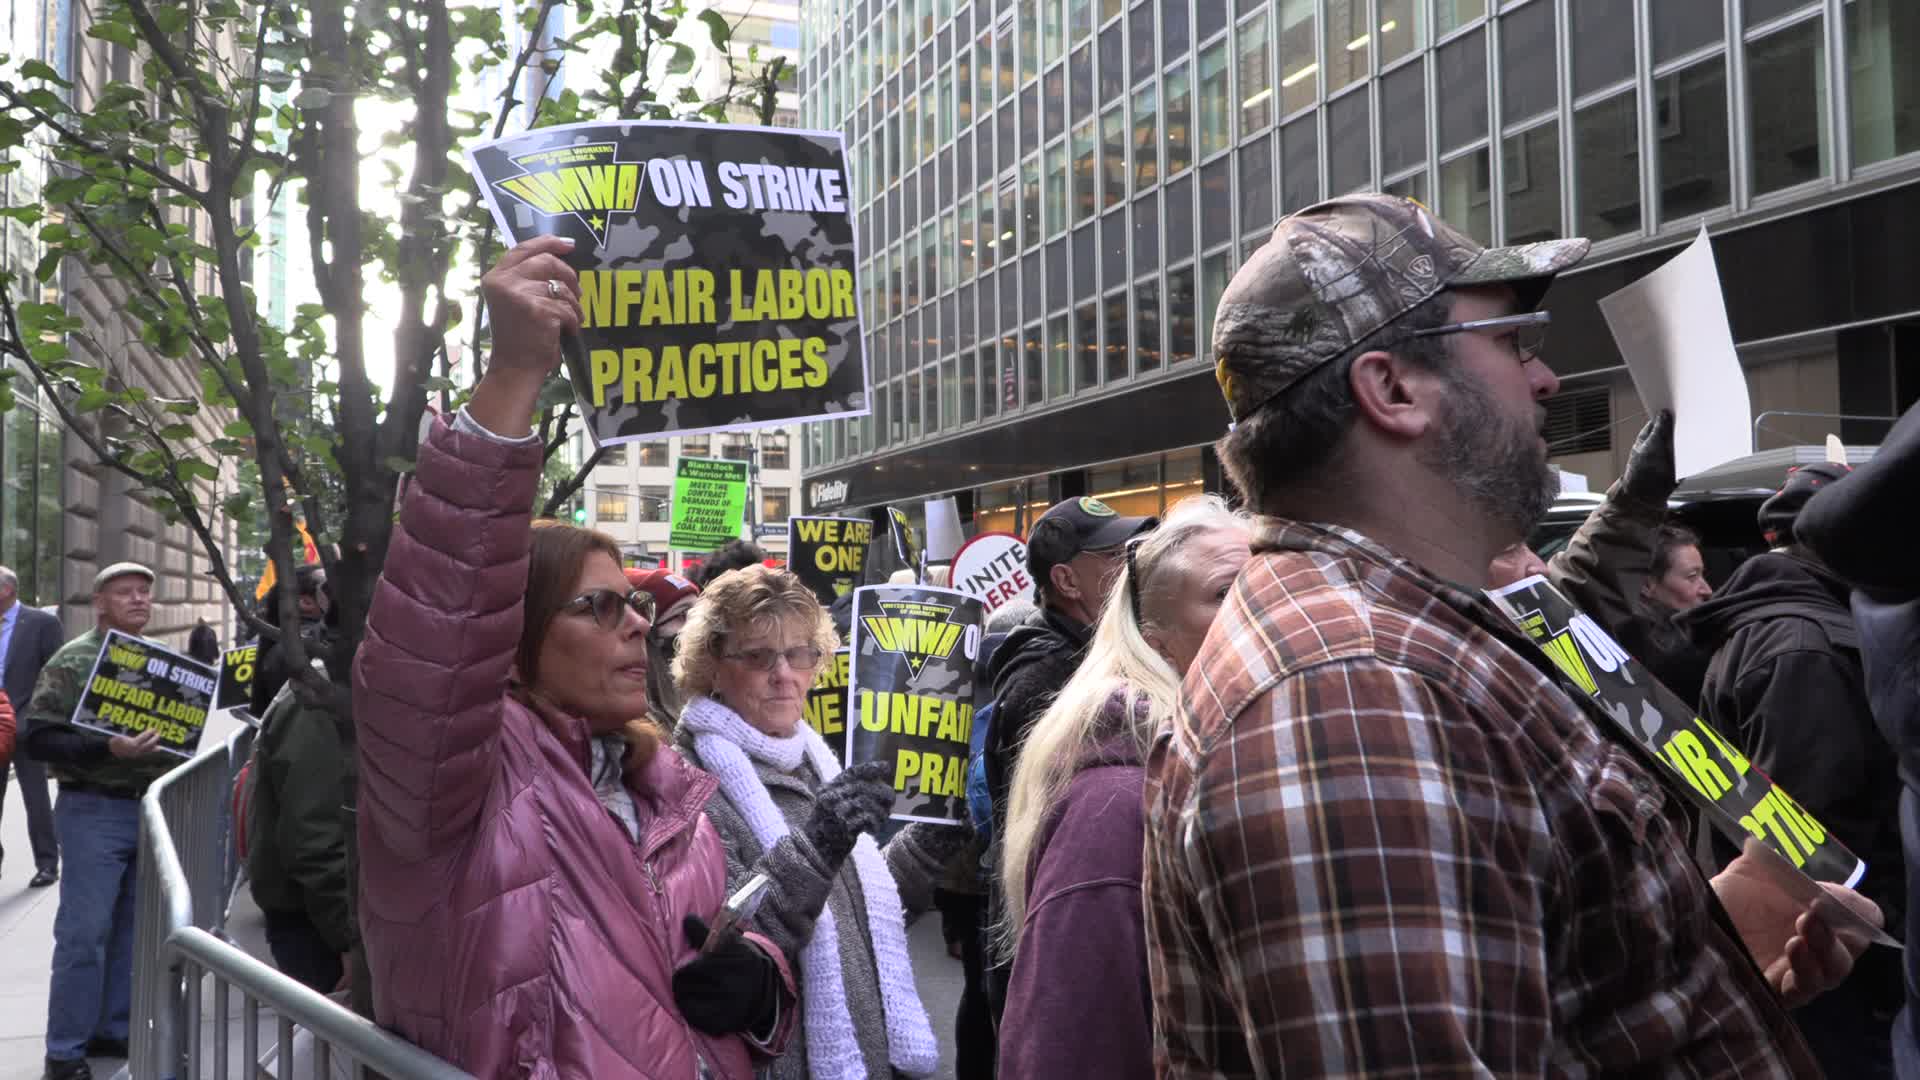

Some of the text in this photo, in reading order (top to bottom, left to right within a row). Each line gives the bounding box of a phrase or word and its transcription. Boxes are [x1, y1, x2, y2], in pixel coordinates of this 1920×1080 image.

[500, 164, 638, 213] UMWA
[647, 158, 846, 213] ON STRIKE
[577, 268, 856, 328] NFAIR LABOR
[589, 336, 829, 407] PRACTICES
[688, 461, 733, 471] Black Rock
[688, 489, 728, 498] CONTRACT
[689, 481, 712, 489] MEET
[817, 480, 848, 503] Fidelity
[681, 496, 719, 505] DEMANDS
[685, 507, 726, 516] STRIKING
[675, 522, 732, 534] COAL MINERS
[684, 515, 723, 525] ALABAMA
[796, 519, 872, 544] WE ARE
[815, 544, 863, 572] ONE
[865, 617, 961, 657] UMWA
[226, 647, 257, 666] WE
[148, 657, 215, 695] ON STRIKE
[91, 675, 208, 726] UNFAIR LABOR
[97, 702, 188, 744] PRACTICES
